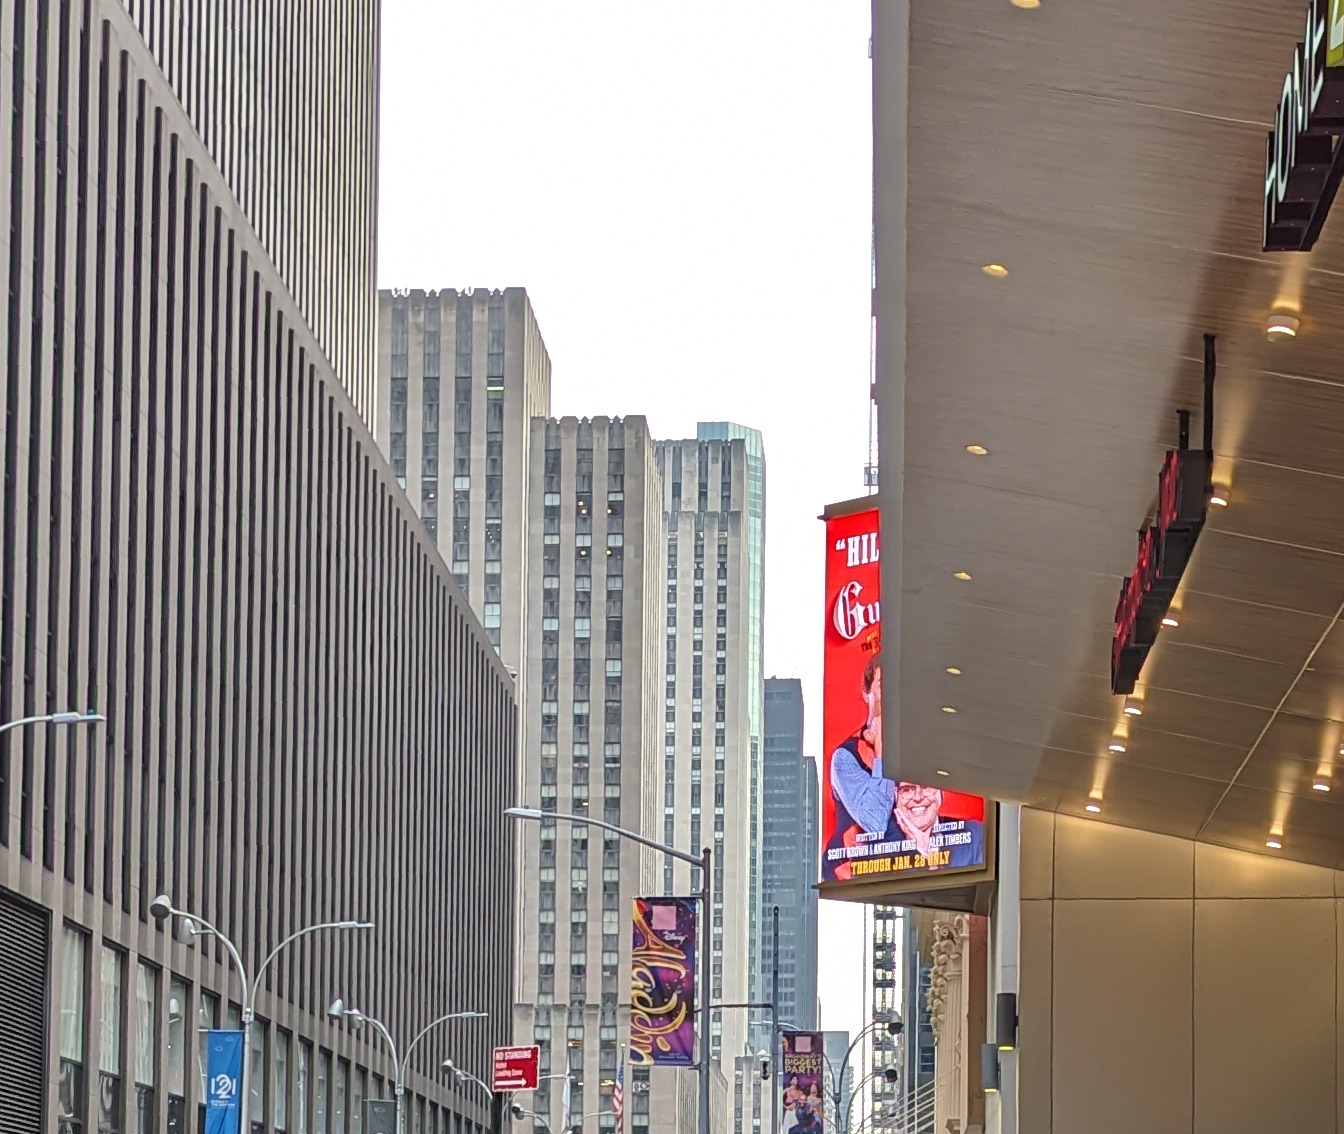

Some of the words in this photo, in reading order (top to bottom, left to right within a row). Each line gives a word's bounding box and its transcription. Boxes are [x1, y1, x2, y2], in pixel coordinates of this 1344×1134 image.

[851, 858, 891, 875] THROUGH
[893, 855, 913, 870] JAN.
[927, 850, 950, 866] ONLY
[785, 1058, 822, 1066] BIGGEST
[210, 1073, 237, 1098] 1221
